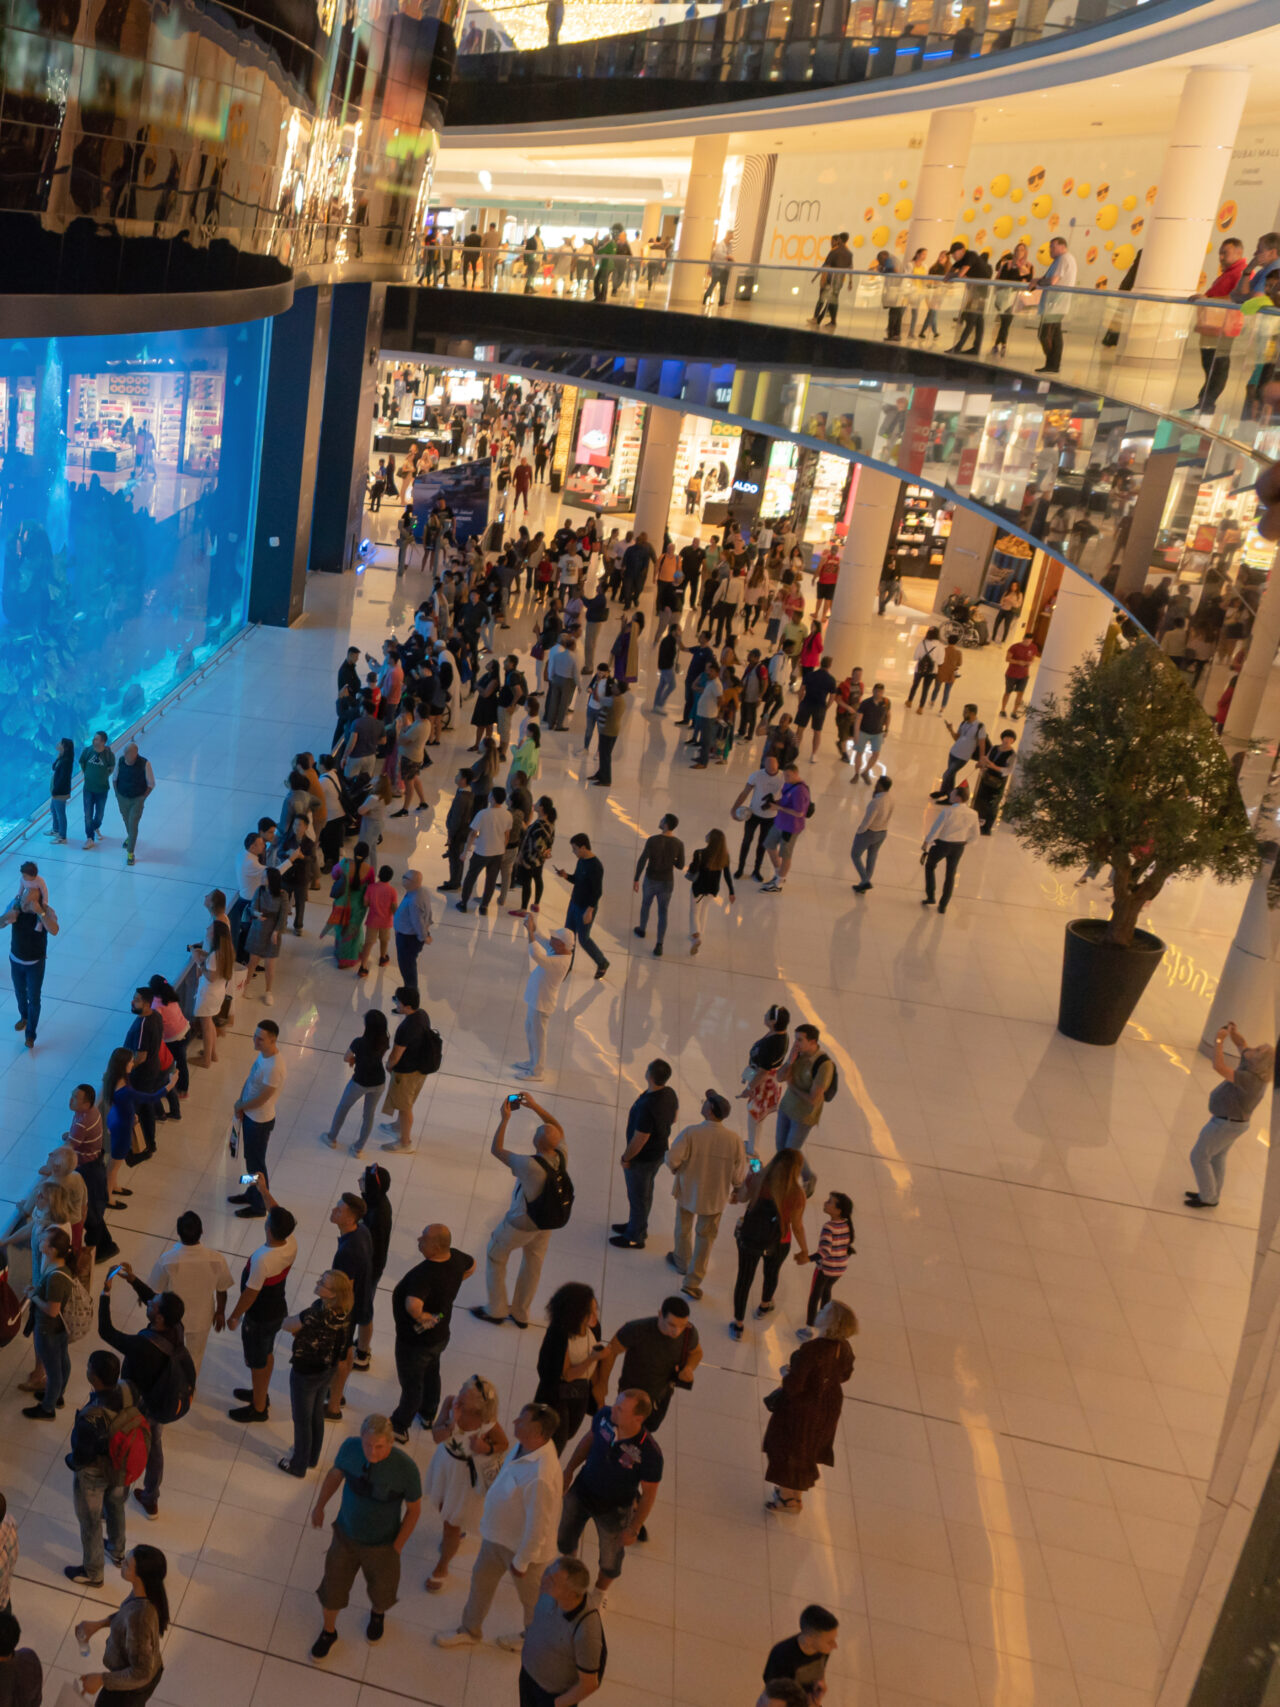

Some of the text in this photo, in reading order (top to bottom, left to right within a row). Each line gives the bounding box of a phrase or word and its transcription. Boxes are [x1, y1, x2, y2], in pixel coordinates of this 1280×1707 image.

[785, 199, 821, 222] am
[769, 226, 836, 267] happ
[732, 480, 759, 494] ALDO
